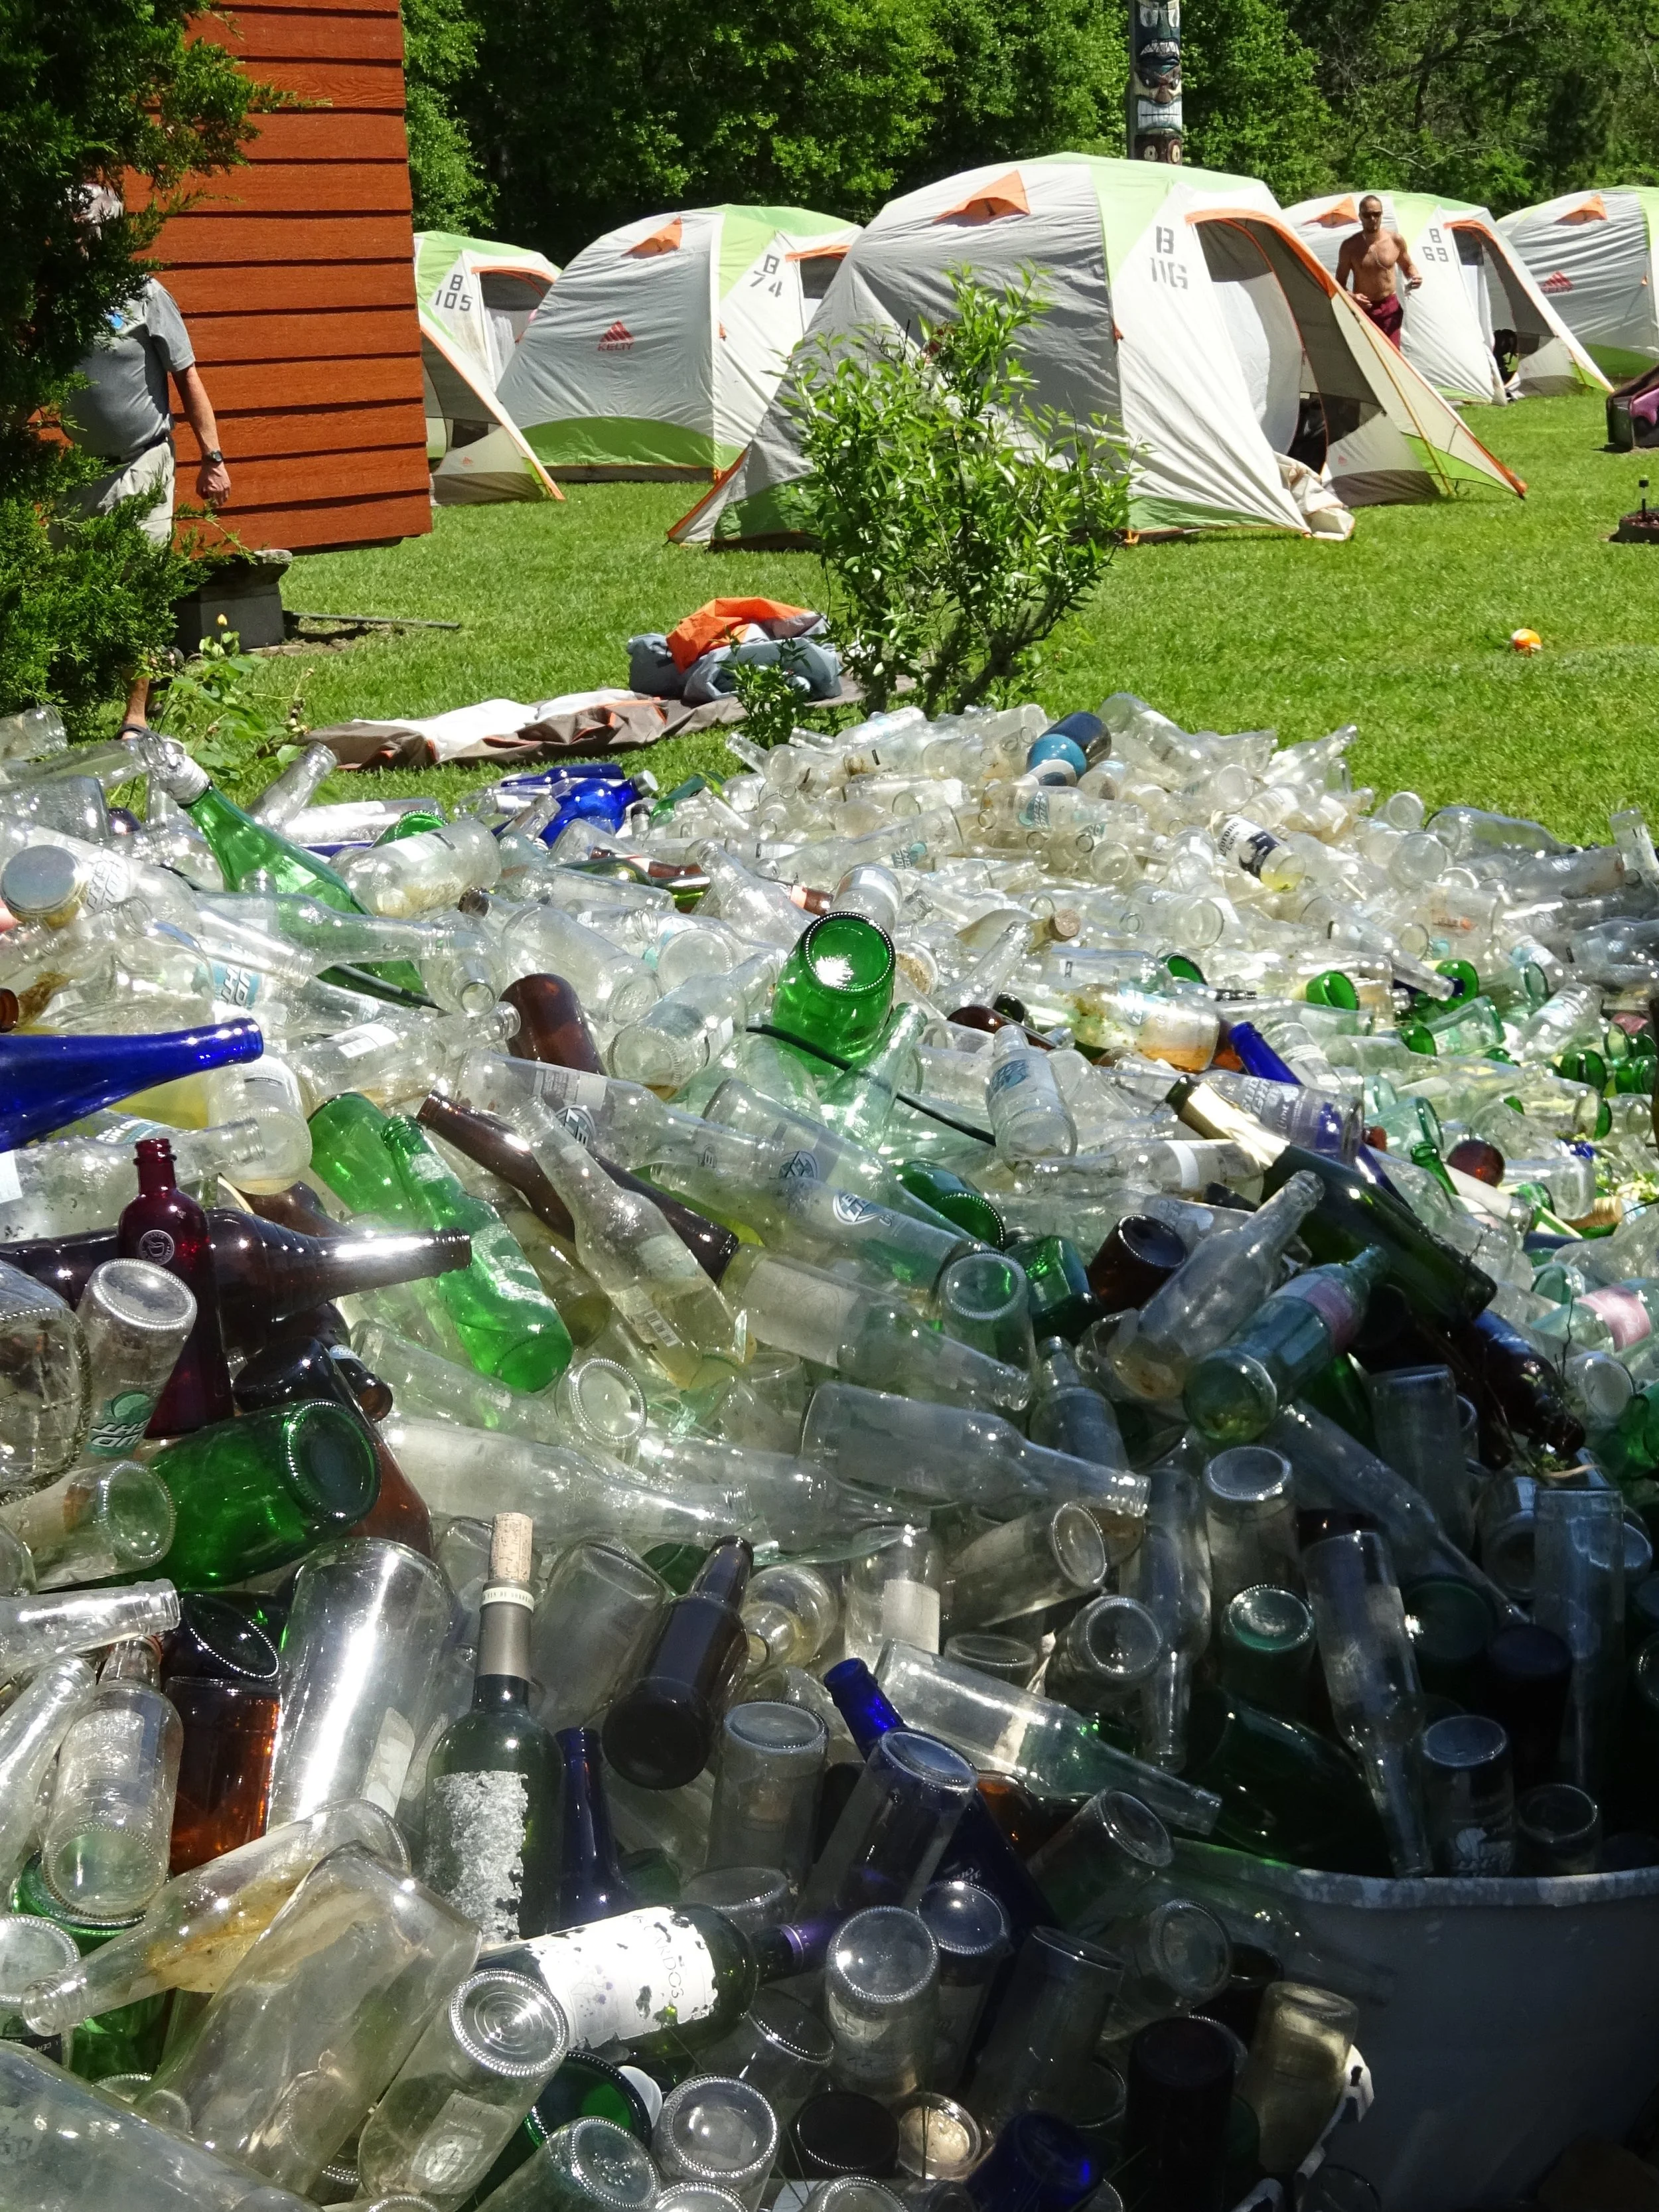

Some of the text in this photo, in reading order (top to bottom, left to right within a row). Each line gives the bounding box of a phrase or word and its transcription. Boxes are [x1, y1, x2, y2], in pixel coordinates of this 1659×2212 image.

[1156, 225, 1174, 255] B
[762, 254, 780, 275] B
[1421, 246, 1449, 262] 69
[749, 270, 782, 298] 74
[435, 289, 473, 312] 105
